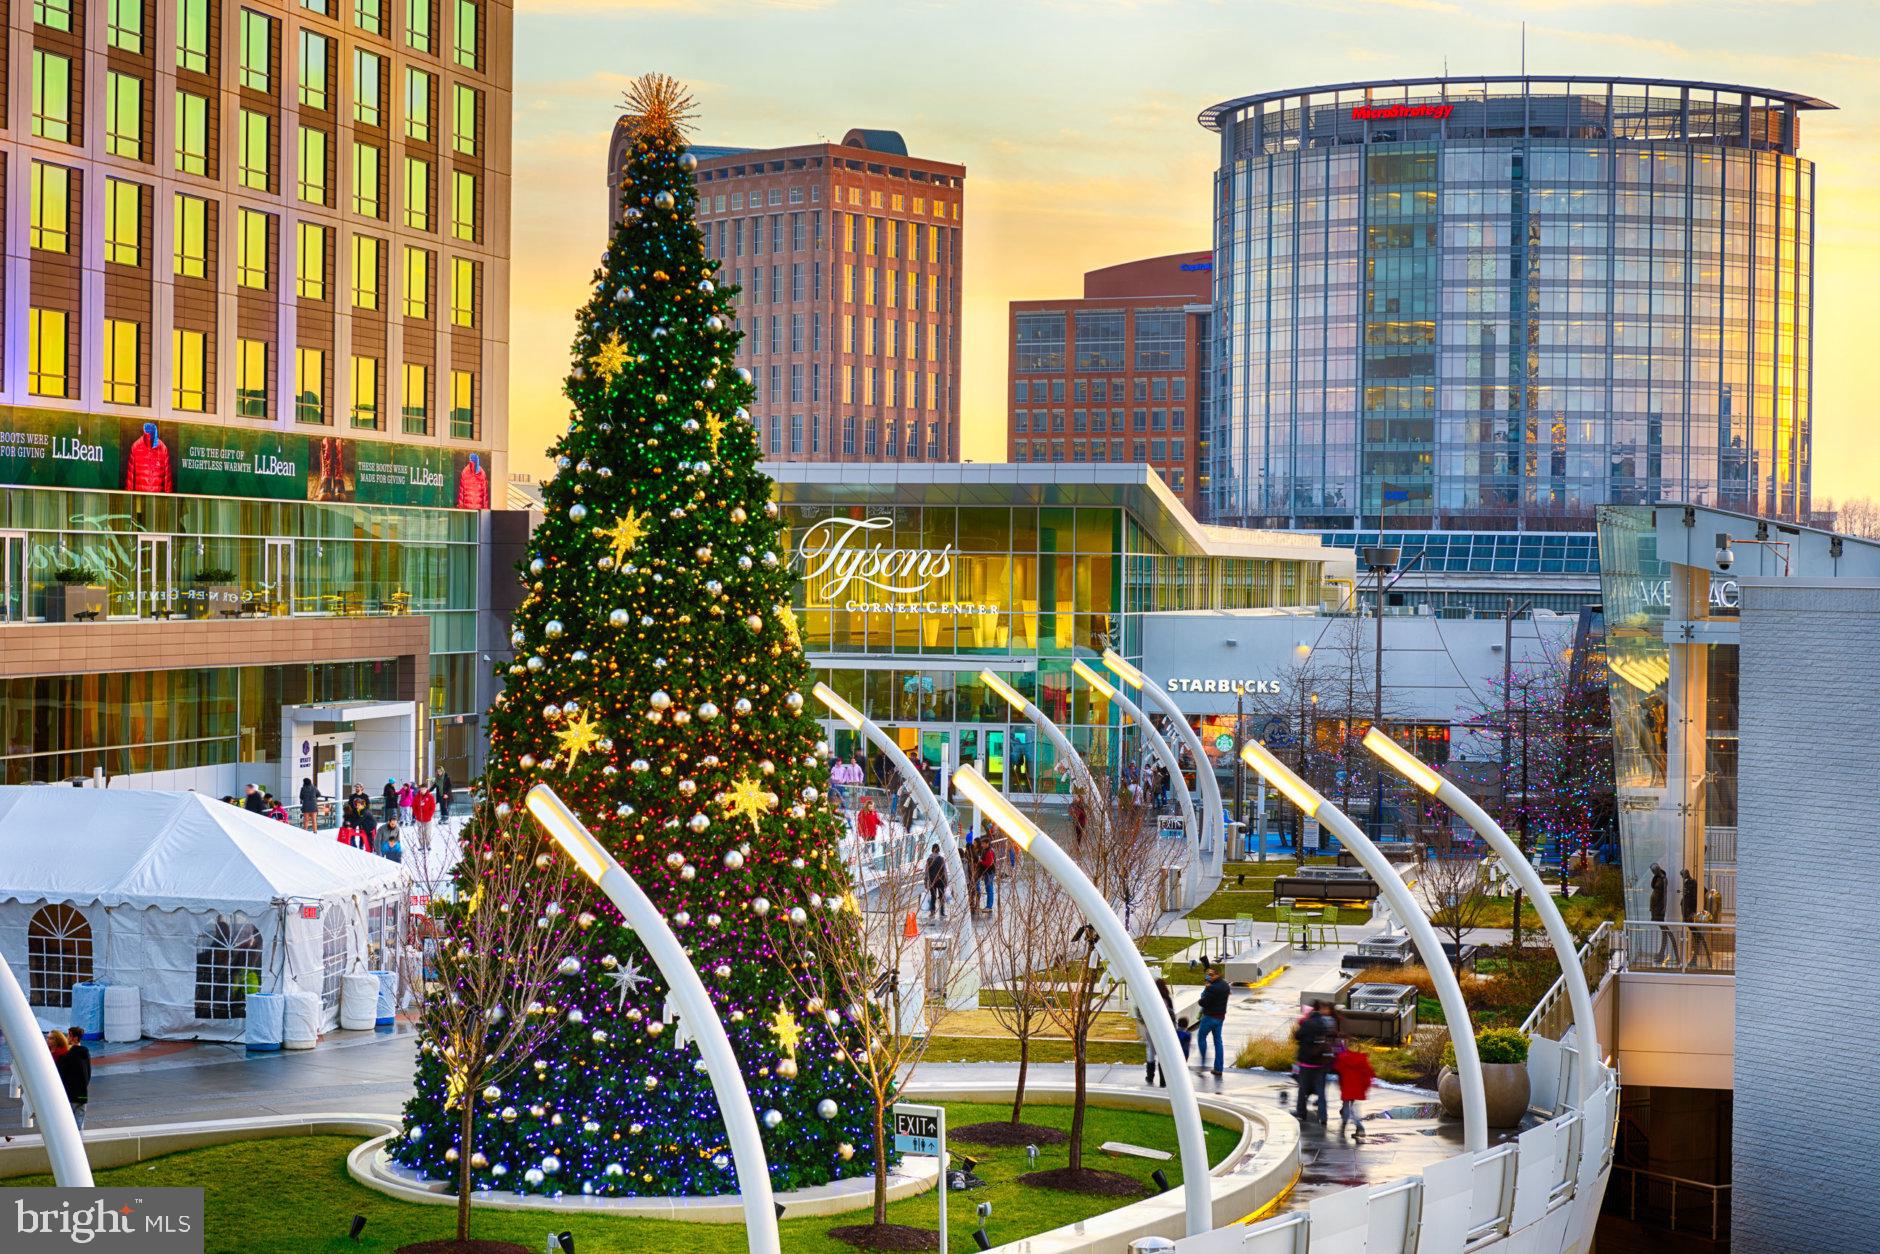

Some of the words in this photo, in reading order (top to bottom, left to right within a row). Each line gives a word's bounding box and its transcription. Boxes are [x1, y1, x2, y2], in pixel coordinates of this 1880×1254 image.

[1351, 104, 1455, 120] MicroStrategy
[0, 431, 26, 444] BOOTS
[26, 433, 49, 446] WERE
[0, 446, 16, 457] FOR
[17, 446, 45, 459] GIVING
[189, 446, 205, 457] GIVE
[206, 447, 219, 459] THE
[219, 448, 235, 460] GIFT
[236, 450, 245, 461] OF
[181, 458, 223, 471] WEIGHTLESS
[223, 461, 252, 473] WARMTH
[358, 461, 375, 471] THESE
[375, 463, 393, 473] BOOTS
[393, 464, 408, 474] WERE
[360, 472, 375, 483] MADE
[375, 473, 387, 484] FOR
[797, 516, 952, 600] Tysons
[845, 600, 919, 614] CORNER
[926, 601, 1000, 615] CENTER
[1168, 678, 1281, 694] STARBUCKS
[1161, 820, 1179, 830] EXIT
[898, 1115, 928, 1135] EXIT
